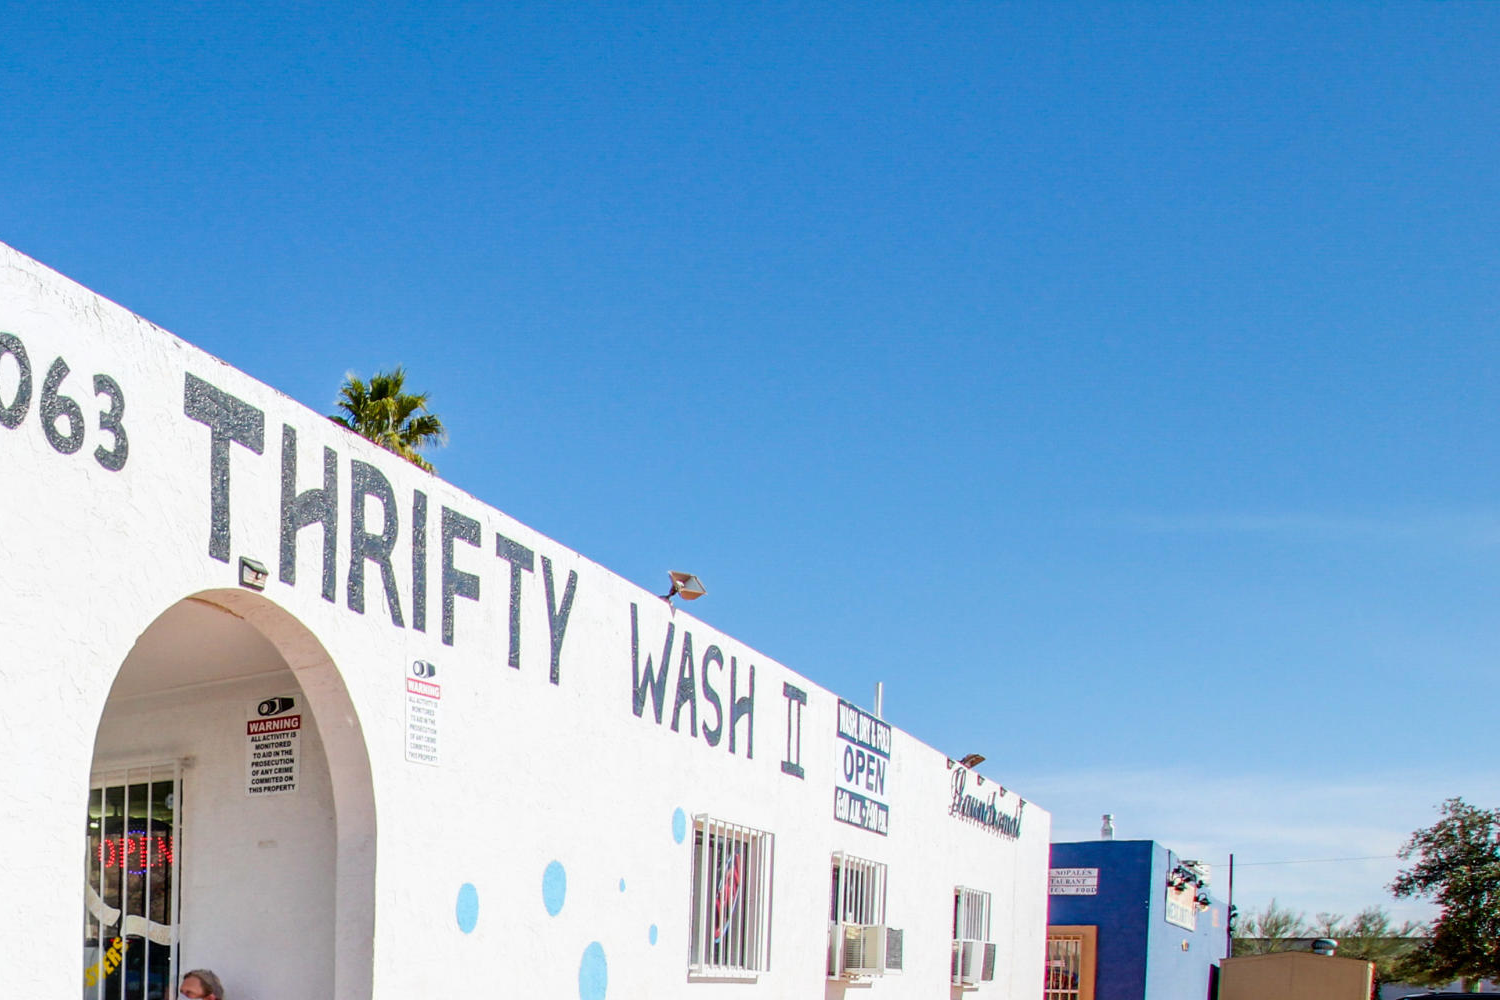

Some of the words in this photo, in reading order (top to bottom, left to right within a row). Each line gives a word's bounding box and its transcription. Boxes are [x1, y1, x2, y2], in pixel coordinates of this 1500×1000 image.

[183, 371, 579, 685] THRIFTY
[630, 601, 756, 760] WASH
[781, 681, 808, 780] II
[249, 717, 299, 733] WARNING
[262, 732, 289, 742] ACTIVITY
[255, 740, 292, 750] MONITORED
[251, 758, 295, 768] PROSECUTION
[274, 766, 293, 775] CRIME
[843, 744, 886, 796] OPEN
[263, 784, 296, 793] PROPERTY
[97, 836, 174, 868] OPEN
